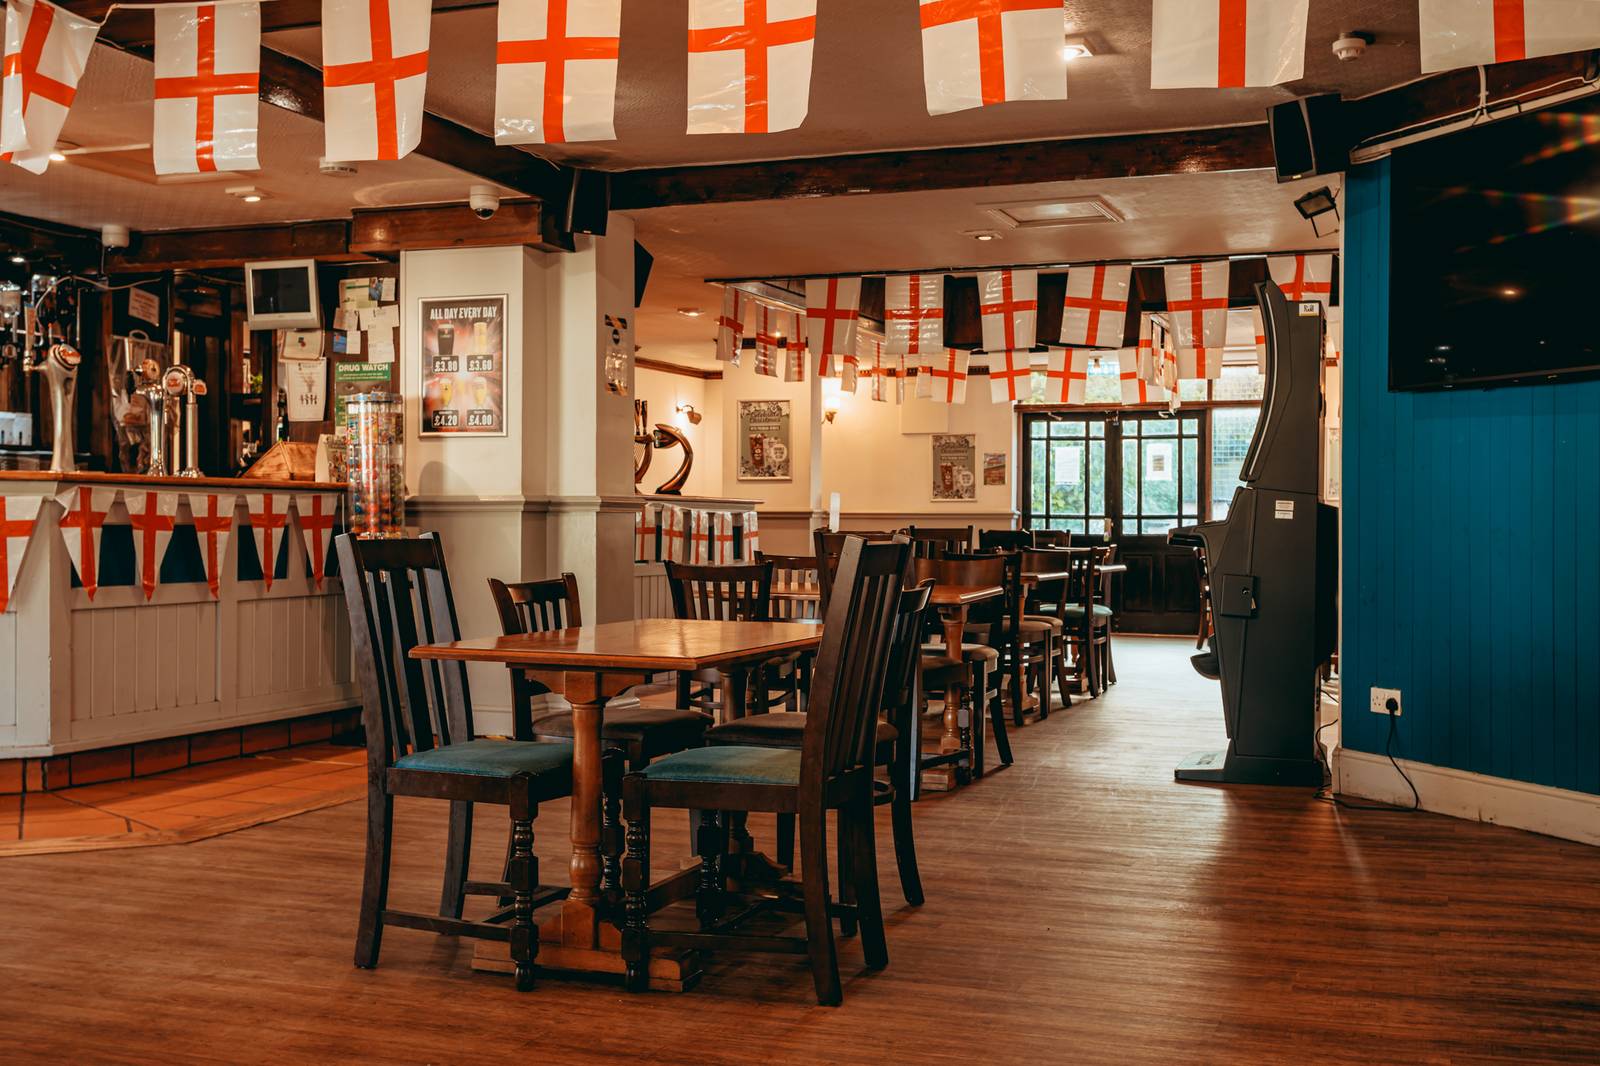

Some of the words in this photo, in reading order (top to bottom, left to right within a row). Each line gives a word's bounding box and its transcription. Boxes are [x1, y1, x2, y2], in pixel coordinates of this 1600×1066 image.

[430, 308, 443, 320] ALL
[444, 308, 458, 320] DAY
[458, 306, 482, 319] EVERY
[482, 306, 497, 318] DAY
[338, 364, 360, 372] DRUG
[362, 363, 388, 371] WATCH
[434, 414, 458, 426] £4.20
